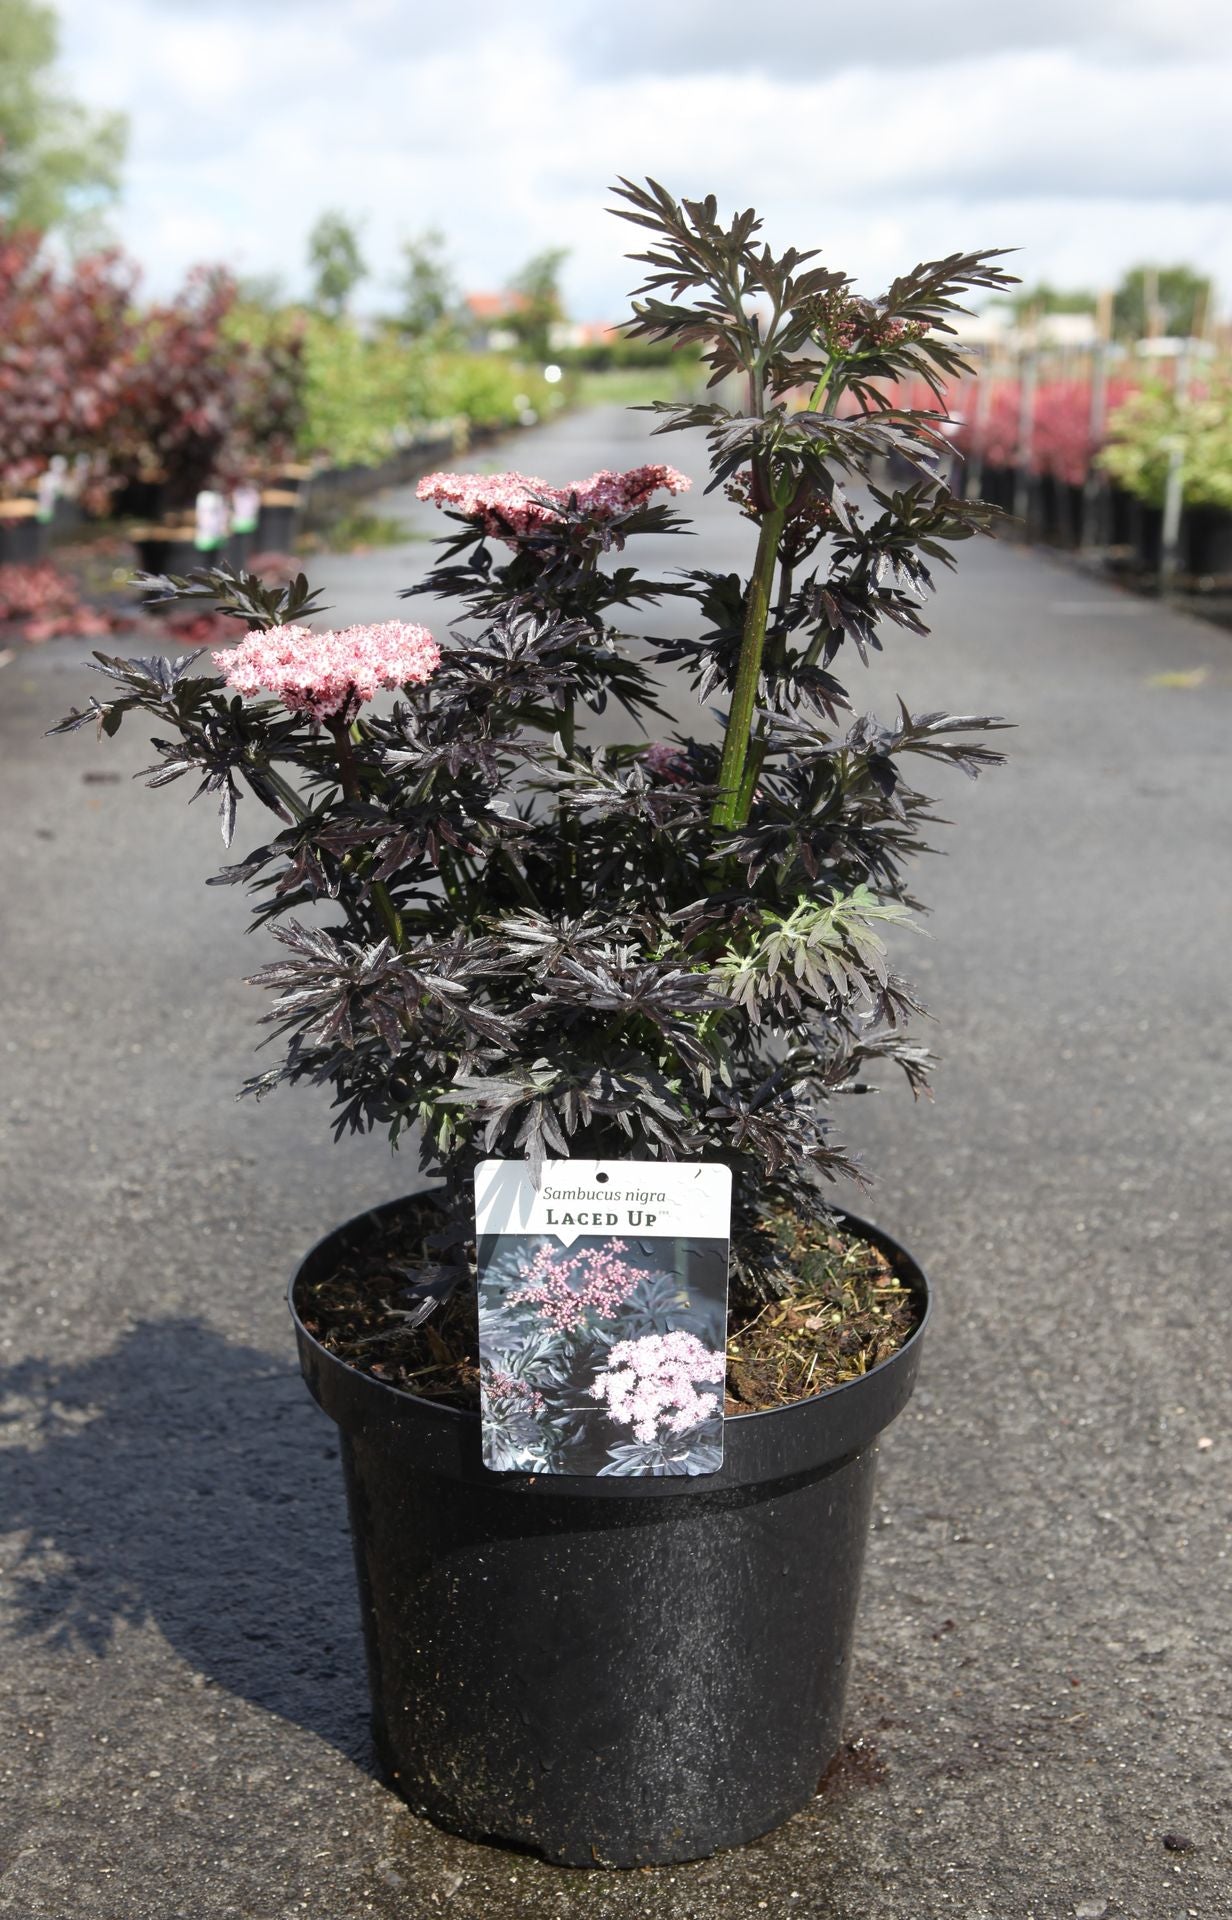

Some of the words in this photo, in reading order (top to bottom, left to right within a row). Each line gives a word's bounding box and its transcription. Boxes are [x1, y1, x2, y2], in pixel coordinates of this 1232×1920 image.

[543, 1187, 621, 1201] Sambucus
[625, 1188, 666, 1205] nigra
[546, 1209, 618, 1226] LACED
